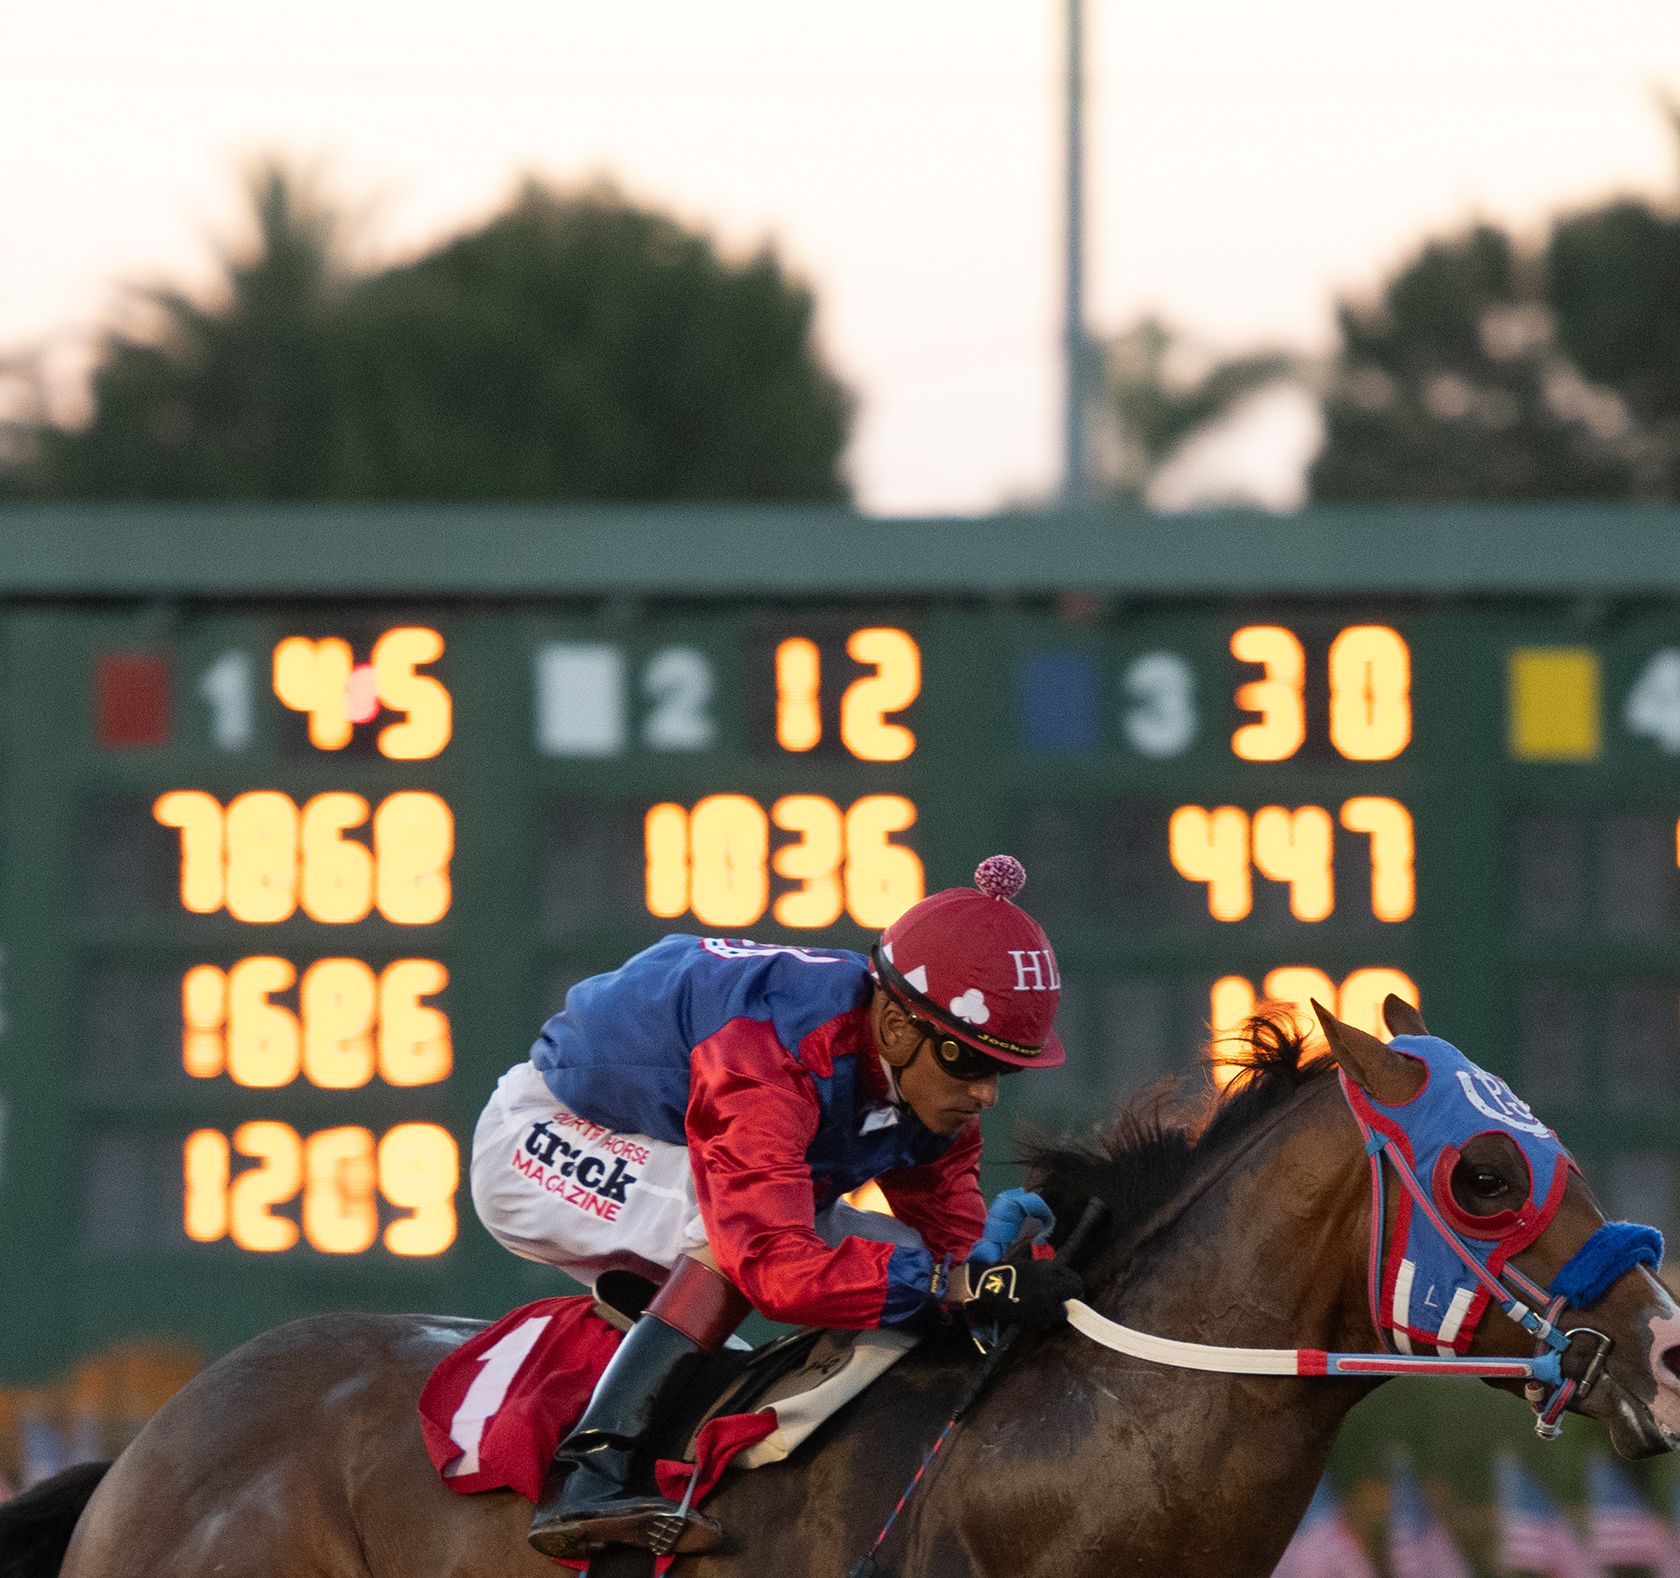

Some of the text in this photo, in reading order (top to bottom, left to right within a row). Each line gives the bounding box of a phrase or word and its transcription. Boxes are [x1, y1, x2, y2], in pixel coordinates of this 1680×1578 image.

[196, 648, 254, 752] 1
[642, 642, 716, 752] 2
[1120, 624, 1413, 762] 3 30
[643, 792, 926, 930] 1036
[1168, 795, 1416, 923] 447
[525, 1120, 637, 1204] track
[443, 1314, 553, 1479] 1
